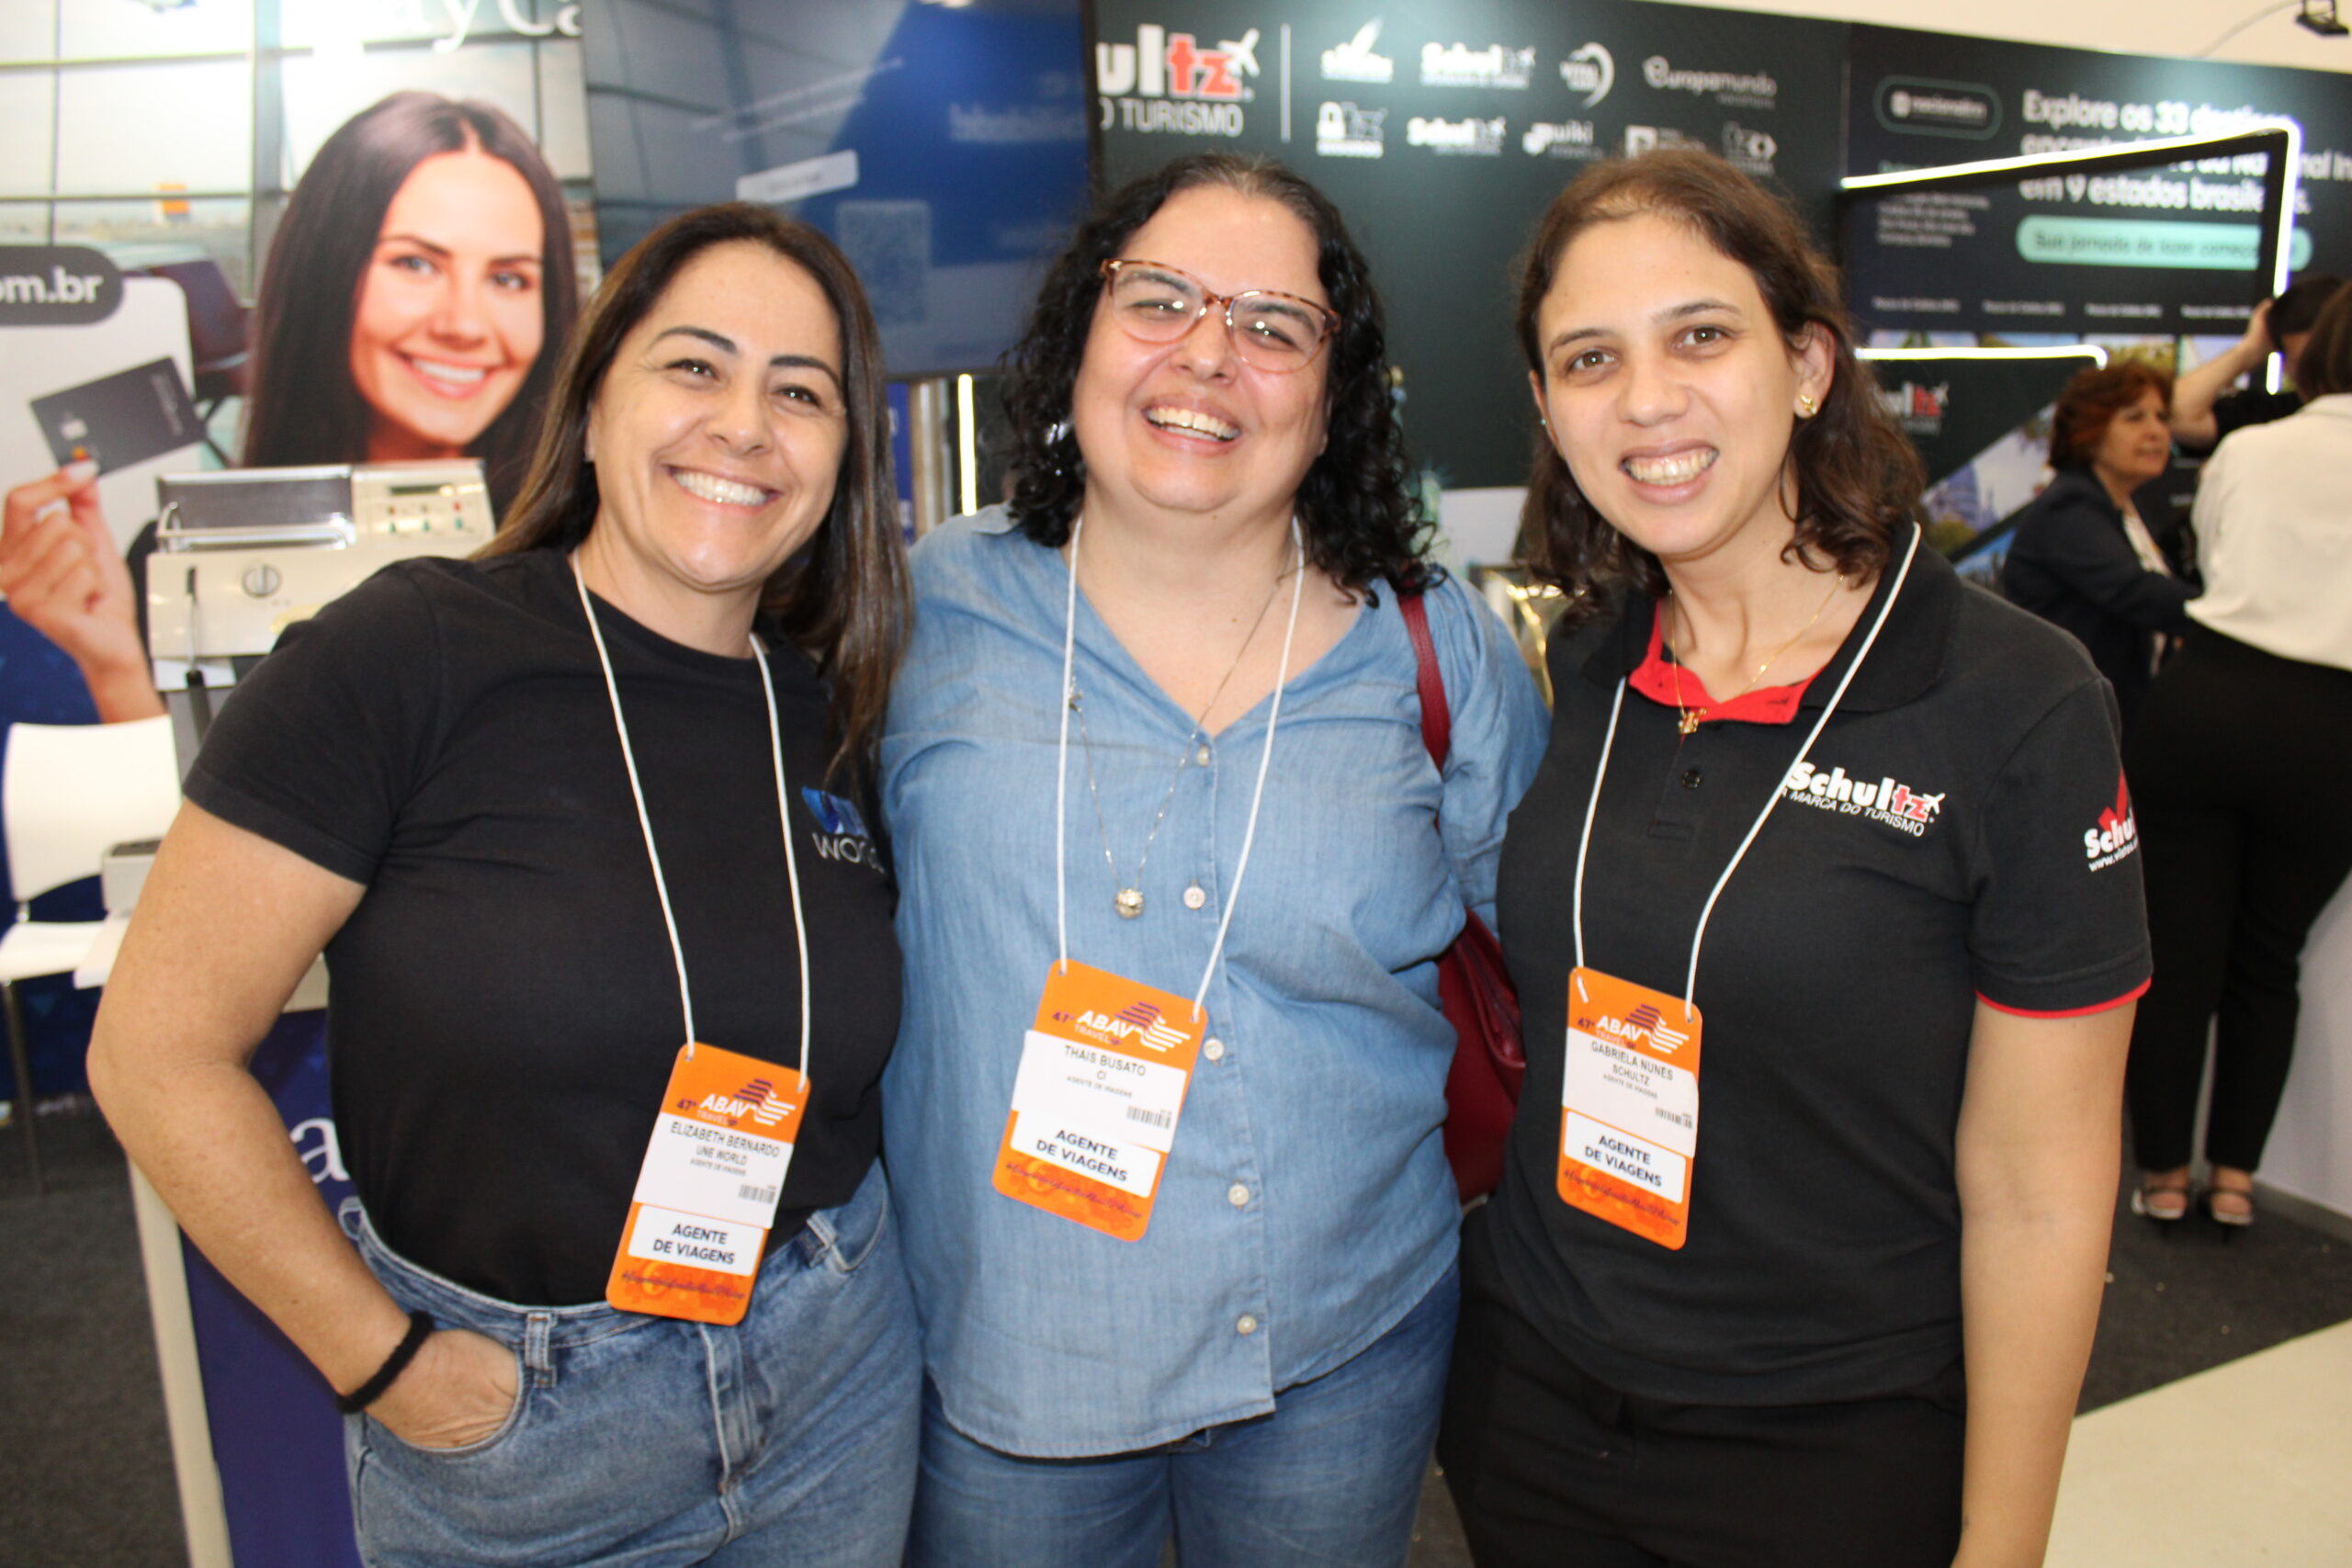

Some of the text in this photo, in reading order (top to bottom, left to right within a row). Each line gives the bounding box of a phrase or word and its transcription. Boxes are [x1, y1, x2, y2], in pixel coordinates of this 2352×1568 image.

[1117, 97, 1244, 137] TURISMO
[2022, 89, 2118, 130] Explore
[2120, 103, 2153, 132] os
[2087, 174, 2188, 209] estados
[1787, 761, 1930, 823] Schultz
[1789, 791, 1837, 811] MARCA
[1839, 802, 1861, 815] DO
[1864, 807, 1926, 838] TURISMO
[1076, 1010, 1136, 1039] ABAV
[1596, 1015, 1644, 1042] ABAV
[1065, 1044, 1147, 1077] THAIS BUSATO
[1591, 1041, 1674, 1081] GABRIELA NUNES
[1612, 1064, 1650, 1086] SCHULTZ
[699, 1093, 751, 1118] ABAV
[671, 1121, 780, 1157] ELIZABETH BERNARDO
[1055, 1129, 1118, 1160] AGENTE
[1599, 1134, 1651, 1166] AGENTE
[716, 1150, 748, 1166] WORLD
[1035, 1139, 1128, 1182] DE VIAGENS
[1584, 1145, 1662, 1188] DE VIAGENS
[672, 1223, 729, 1246] AGENTE
[652, 1238, 736, 1266] DE VIAGENS
